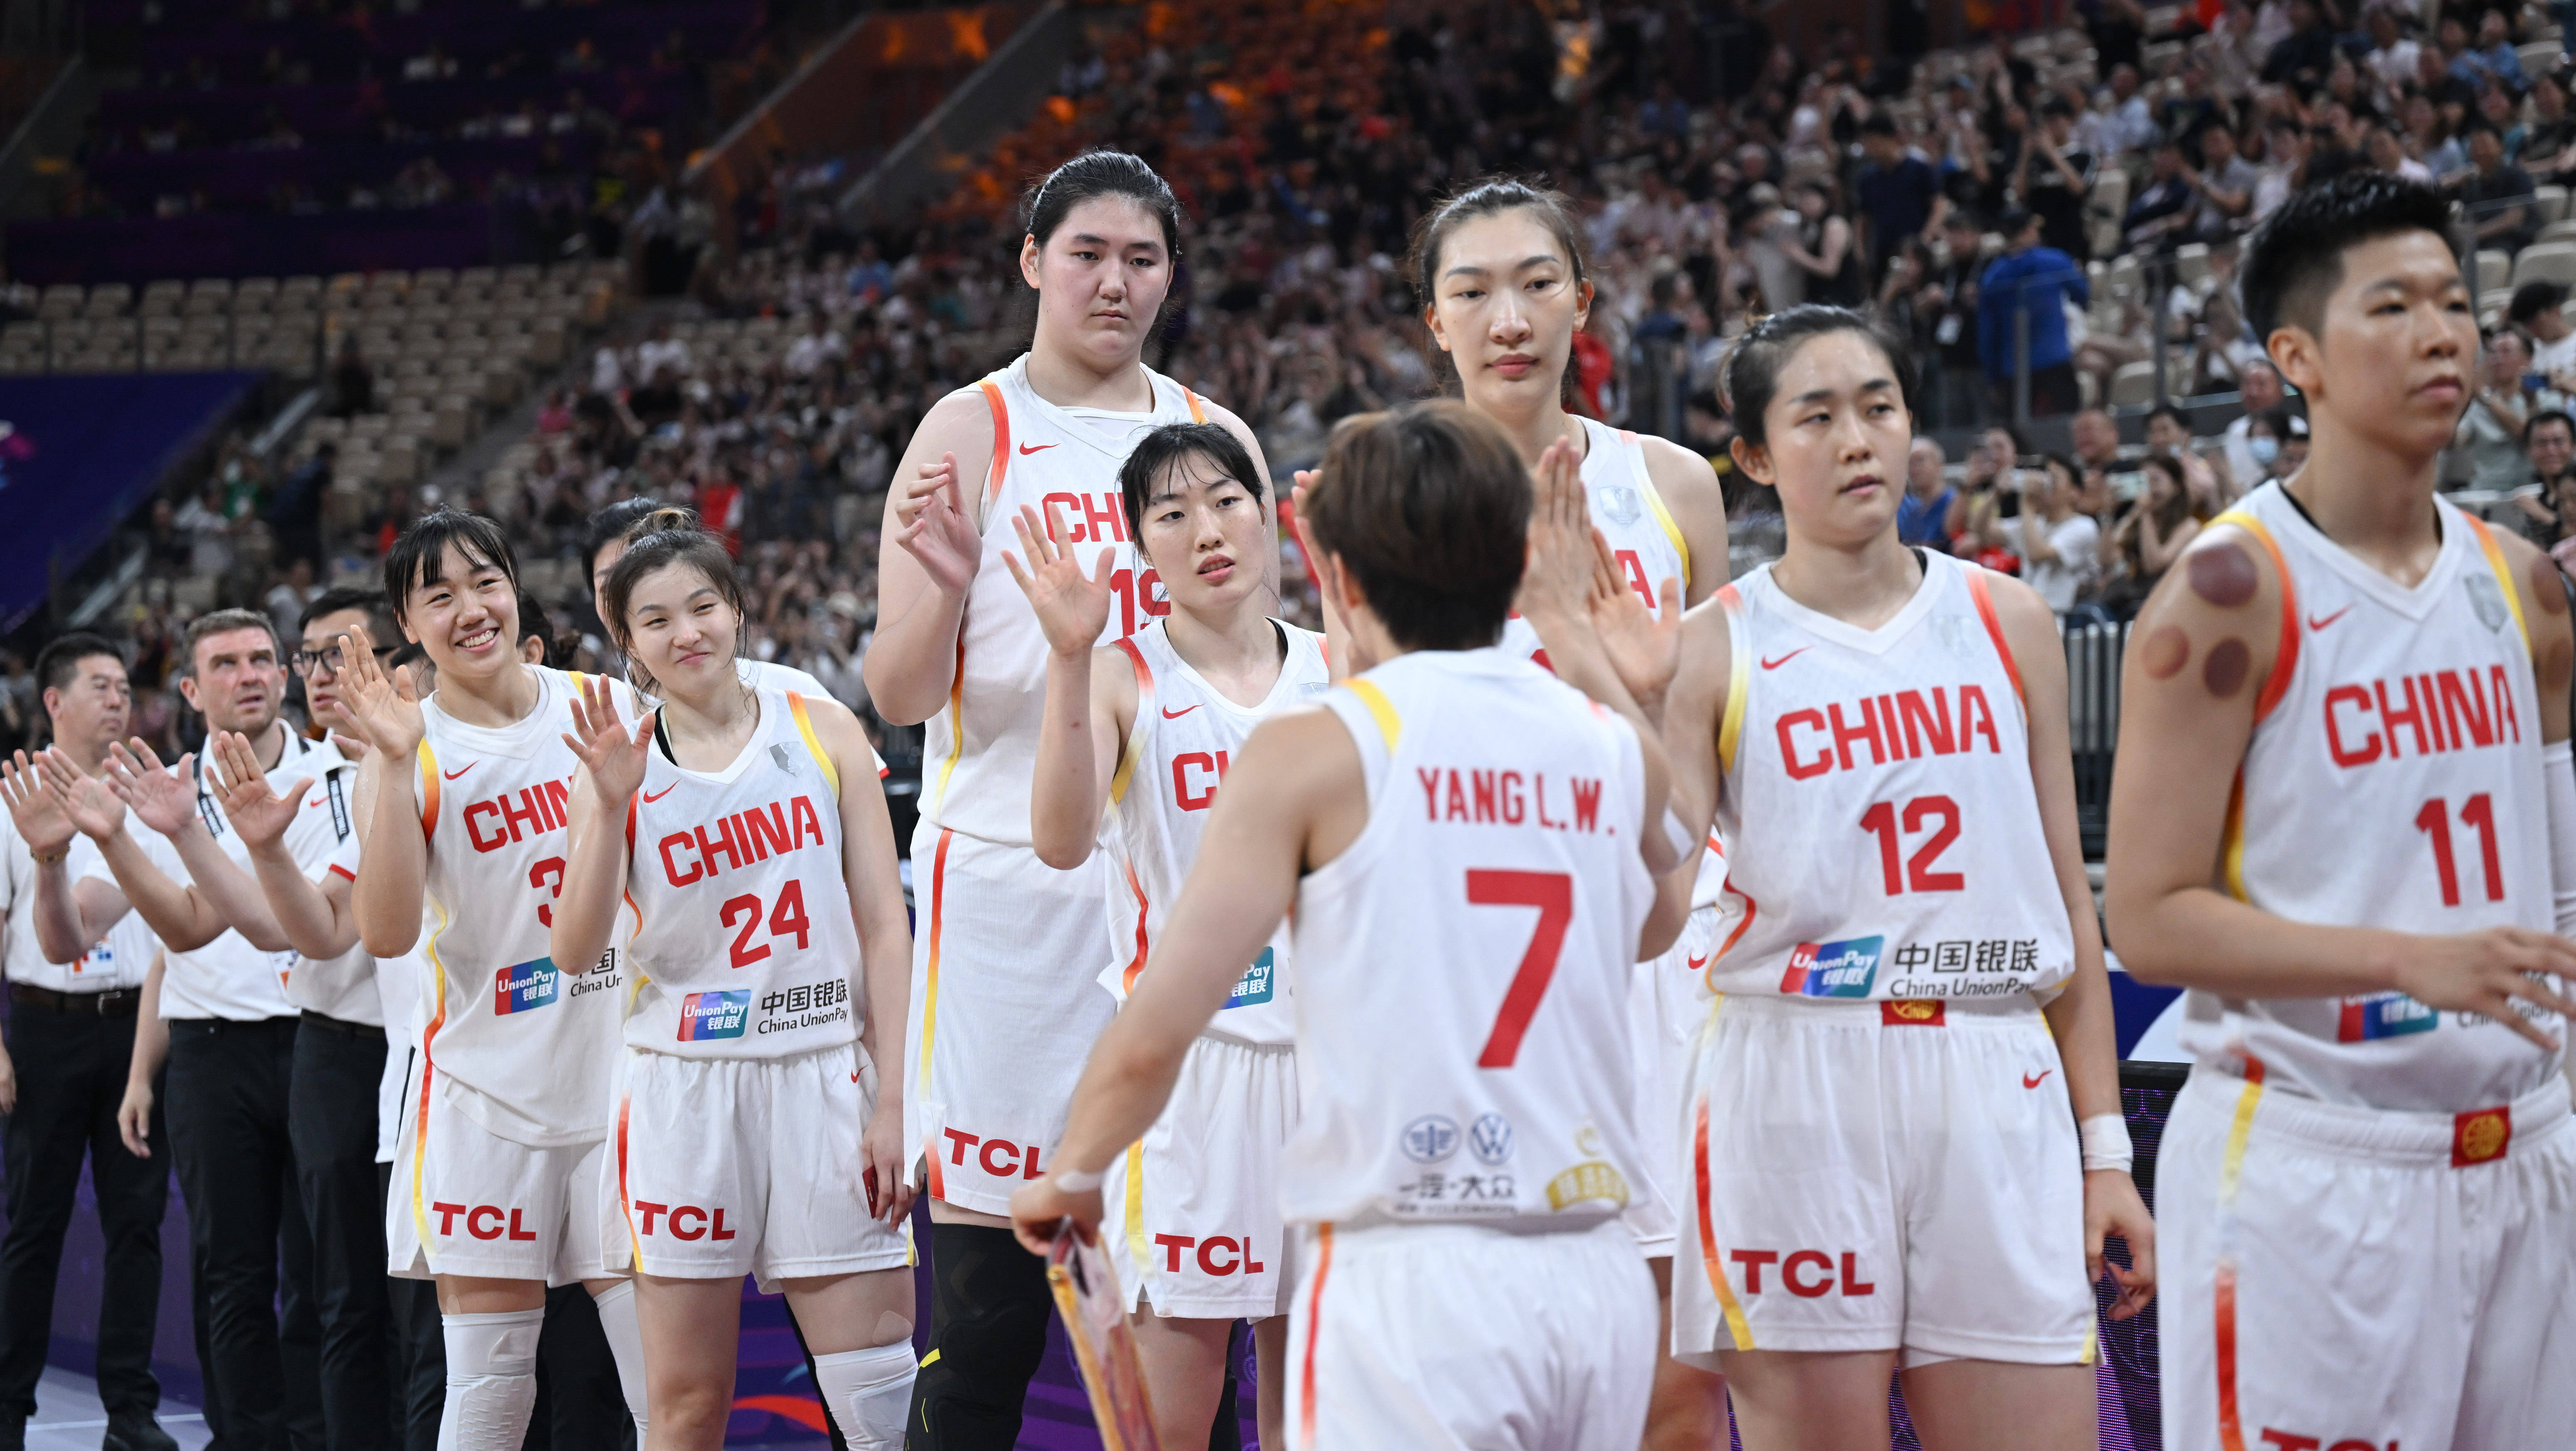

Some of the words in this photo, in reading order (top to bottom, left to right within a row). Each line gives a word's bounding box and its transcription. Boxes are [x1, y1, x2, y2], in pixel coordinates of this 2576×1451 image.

[1042, 492, 1134, 544] CHI
[1775, 685, 2002, 781] CHINA
[2323, 665, 2519, 769] CHINA
[464, 776, 573, 853] CHIN
[1416, 767, 1525, 824] YANG
[1535, 773, 1616, 835] L.W.
[658, 795, 824, 888] CHINA
[1859, 795, 1964, 896] 12
[2414, 793, 2504, 907] 11
[719, 879, 809, 968] 24
[1465, 868, 1573, 1069] 7
[1792, 951, 1877, 971] UnionPay
[1894, 939, 2038, 974] 中国银联
[498, 970, 556, 992] UnionPay
[523, 983, 553, 1001] 银联
[570, 980, 602, 997] China
[761, 977, 848, 1016] 中国银联
[1890, 978, 1946, 997] China
[684, 1001, 746, 1018] UnionPay
[707, 1016, 740, 1030] 银联
[758, 1017, 797, 1034] China
[801, 1007, 848, 1027] UnionPay
[944, 1126, 1047, 1181] TCL
[432, 1201, 536, 1240] TCL
[635, 1200, 736, 1241] TCL
[1155, 1233, 1264, 1276] TCL
[1731, 1248, 1874, 1297] TCL
